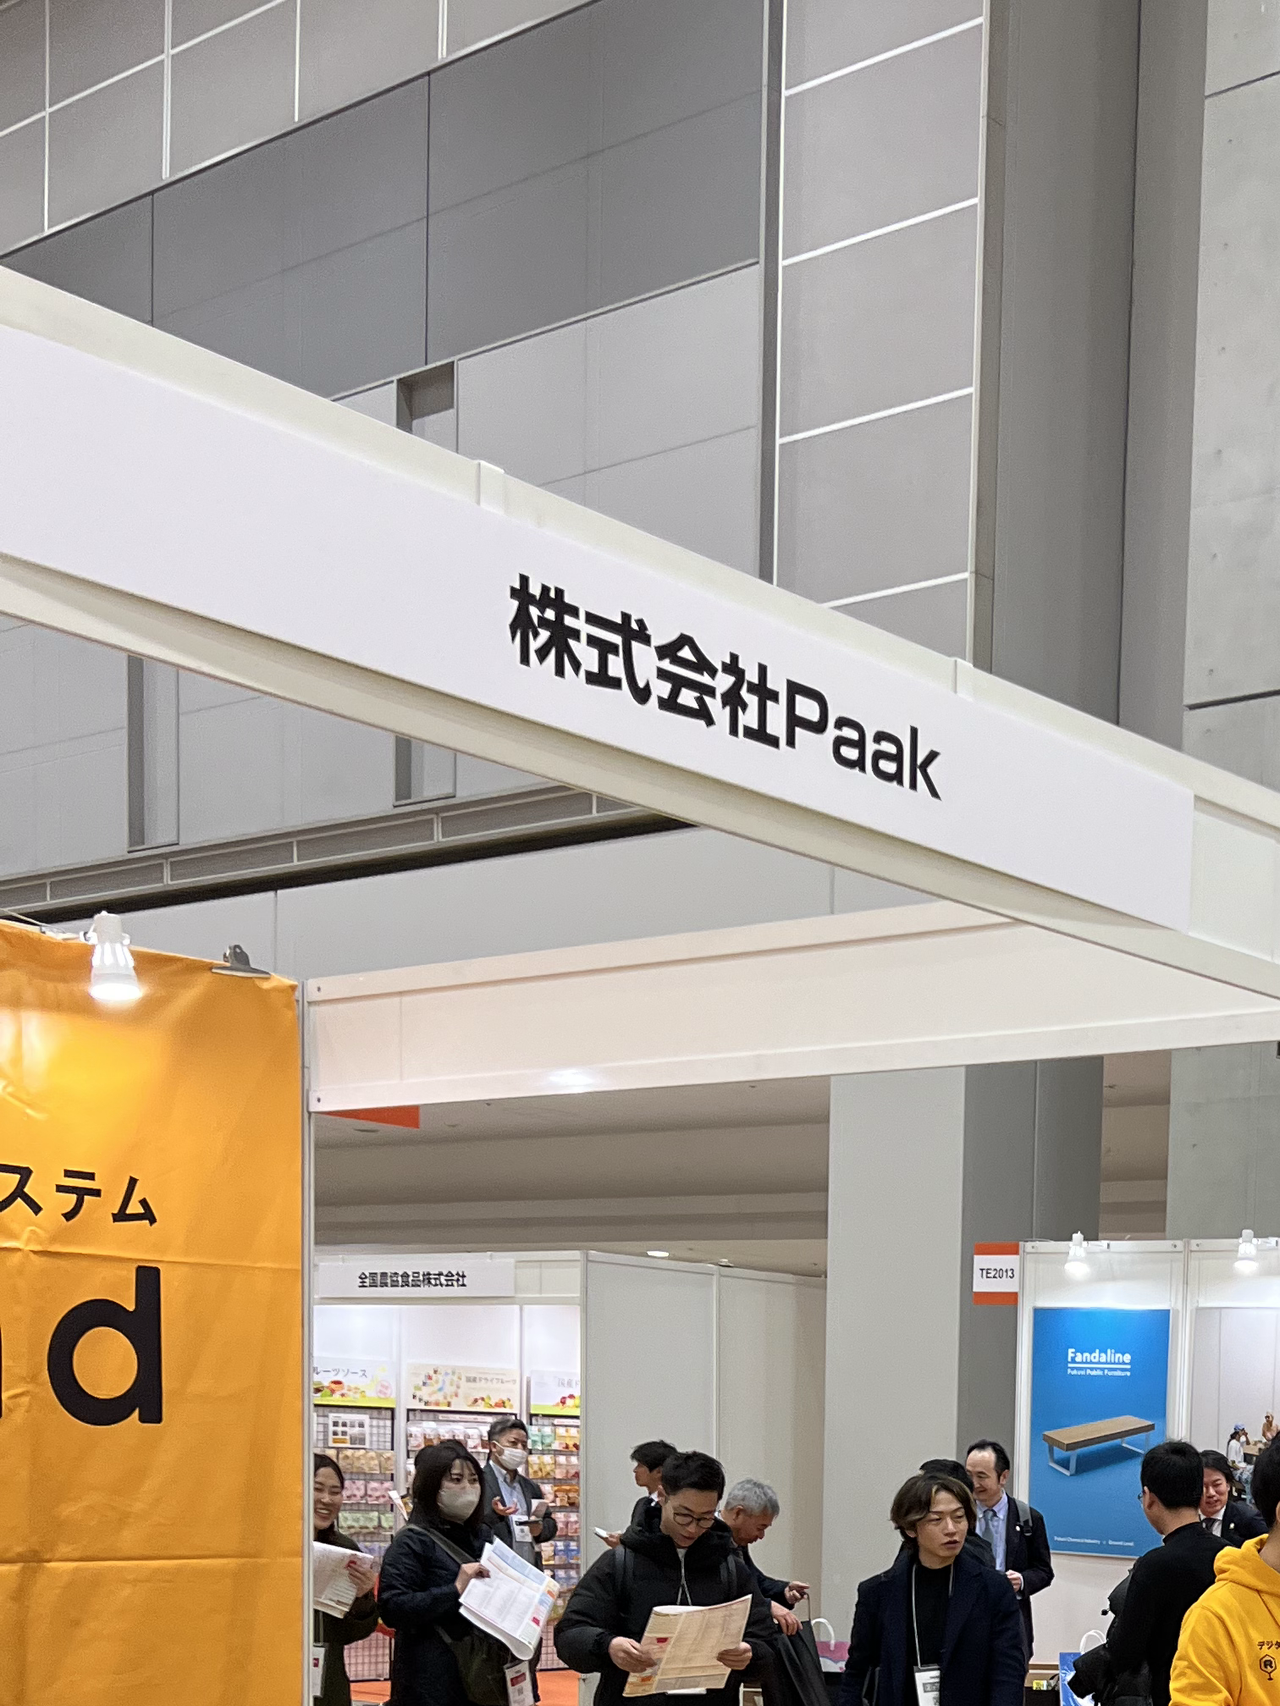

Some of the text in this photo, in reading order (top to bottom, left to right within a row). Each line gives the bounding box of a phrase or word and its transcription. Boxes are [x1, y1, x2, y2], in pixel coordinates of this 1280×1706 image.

[509, 573, 942, 801] 株式会社Paak
[358, 1270, 467, 1288] 全国農協食品株式会社
[979, 1268, 1015, 1280] TE2013
[1067, 1348, 1131, 1363] Fandaline
